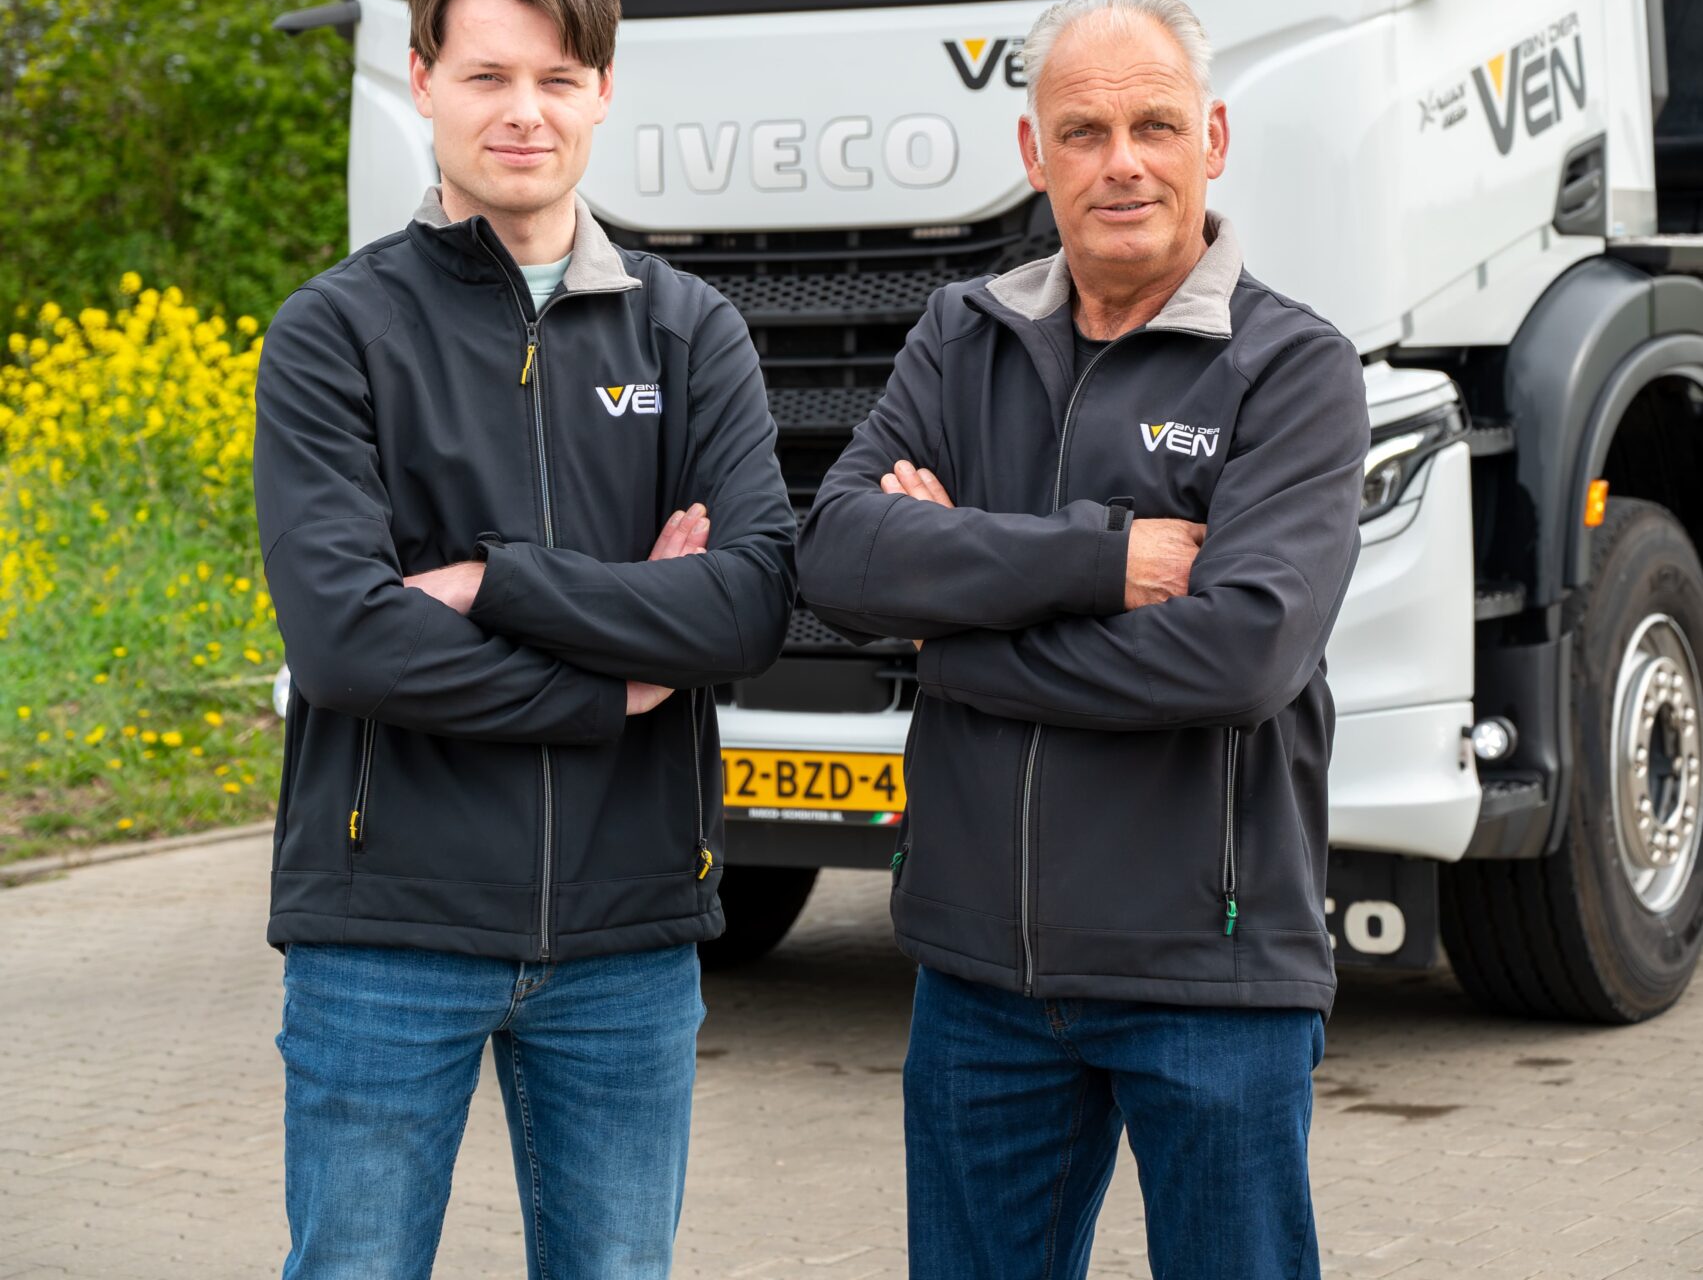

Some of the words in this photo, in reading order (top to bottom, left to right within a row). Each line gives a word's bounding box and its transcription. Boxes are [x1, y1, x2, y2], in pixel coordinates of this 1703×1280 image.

[942, 38, 1028, 90] VE
[1471, 34, 1586, 156] VEN
[635, 112, 960, 197] IVECO
[1139, 421, 1219, 457] VEN
